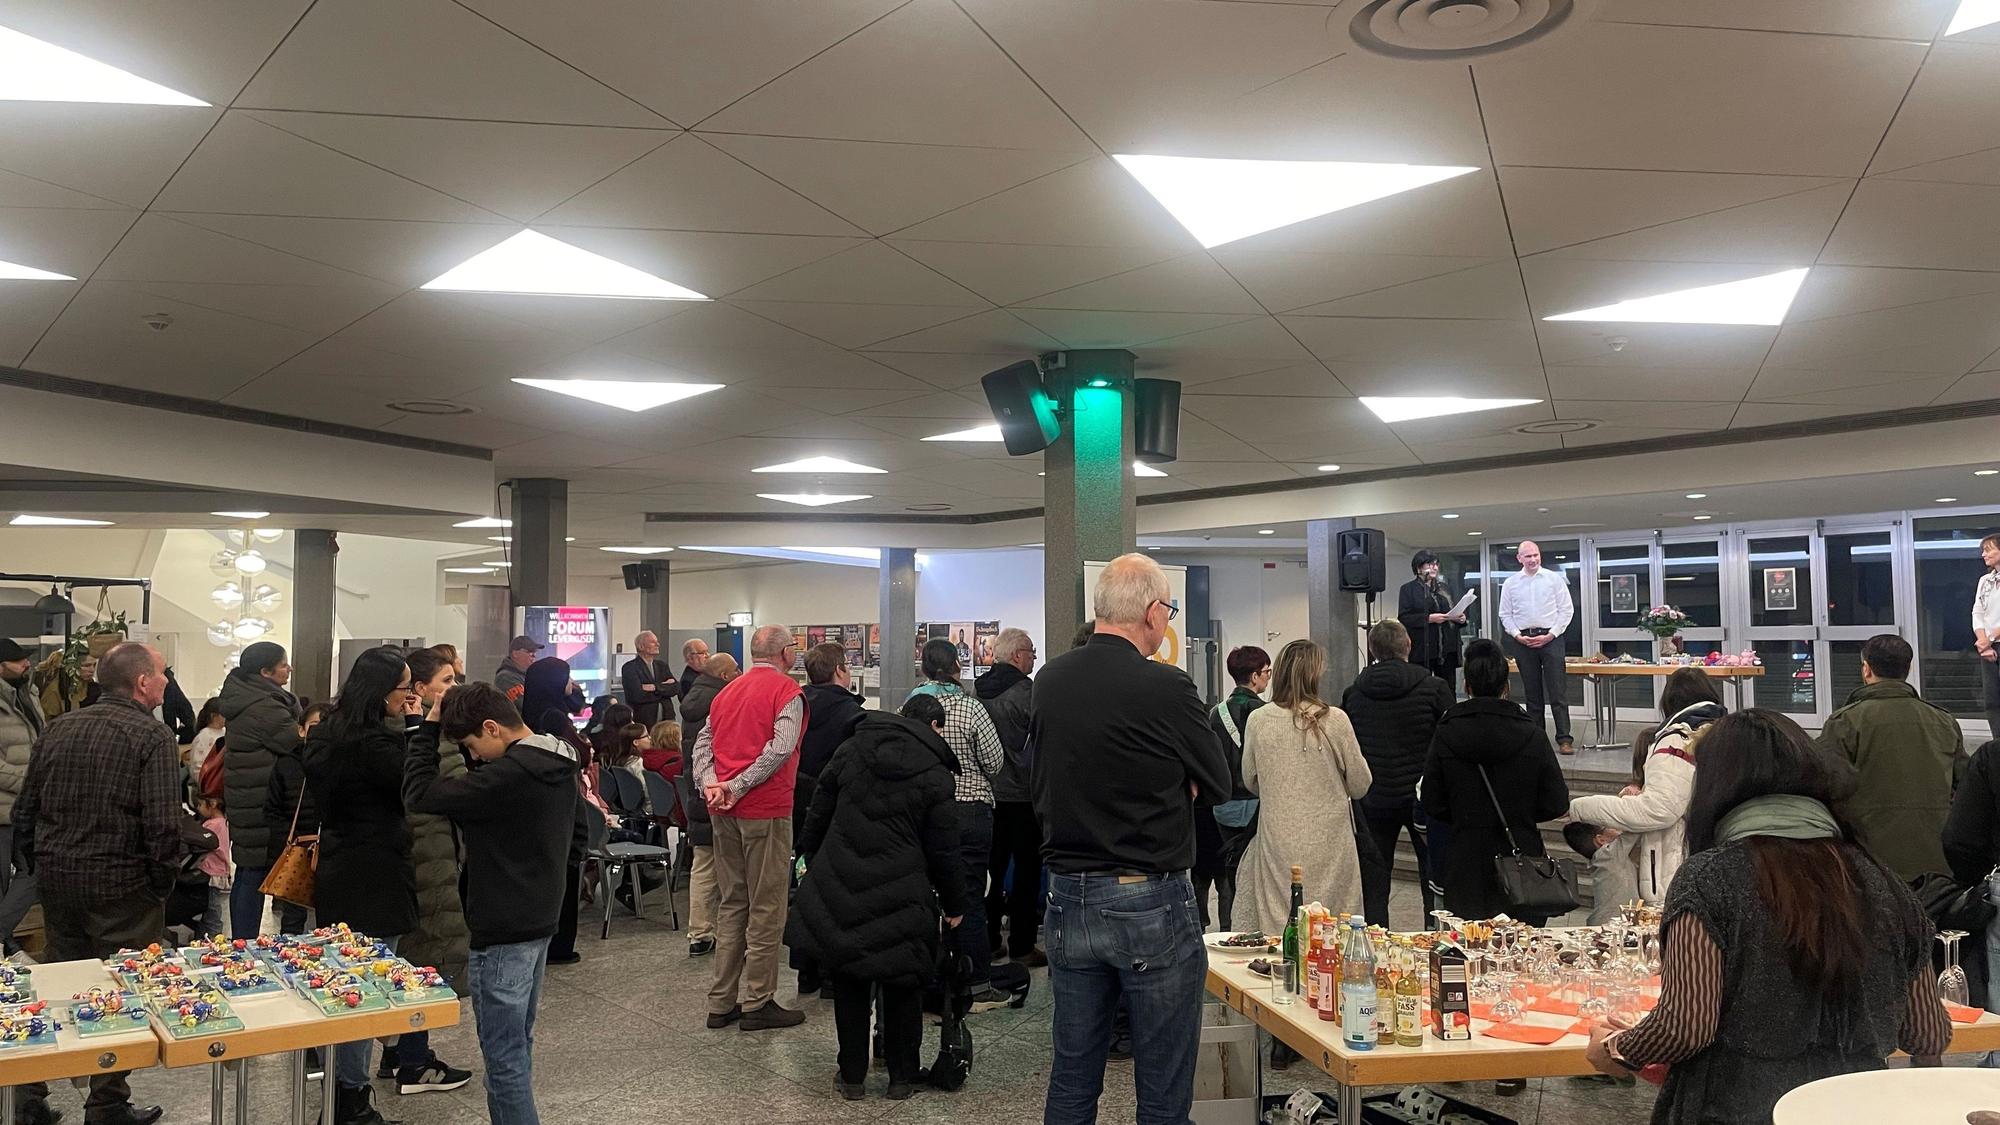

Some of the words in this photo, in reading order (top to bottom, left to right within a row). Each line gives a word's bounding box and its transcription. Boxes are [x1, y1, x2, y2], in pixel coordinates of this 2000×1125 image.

[548, 620, 595, 635] FORUM
[548, 634, 595, 644] LEVERKUSEN
[1397, 1001, 1415, 1011] FASS
